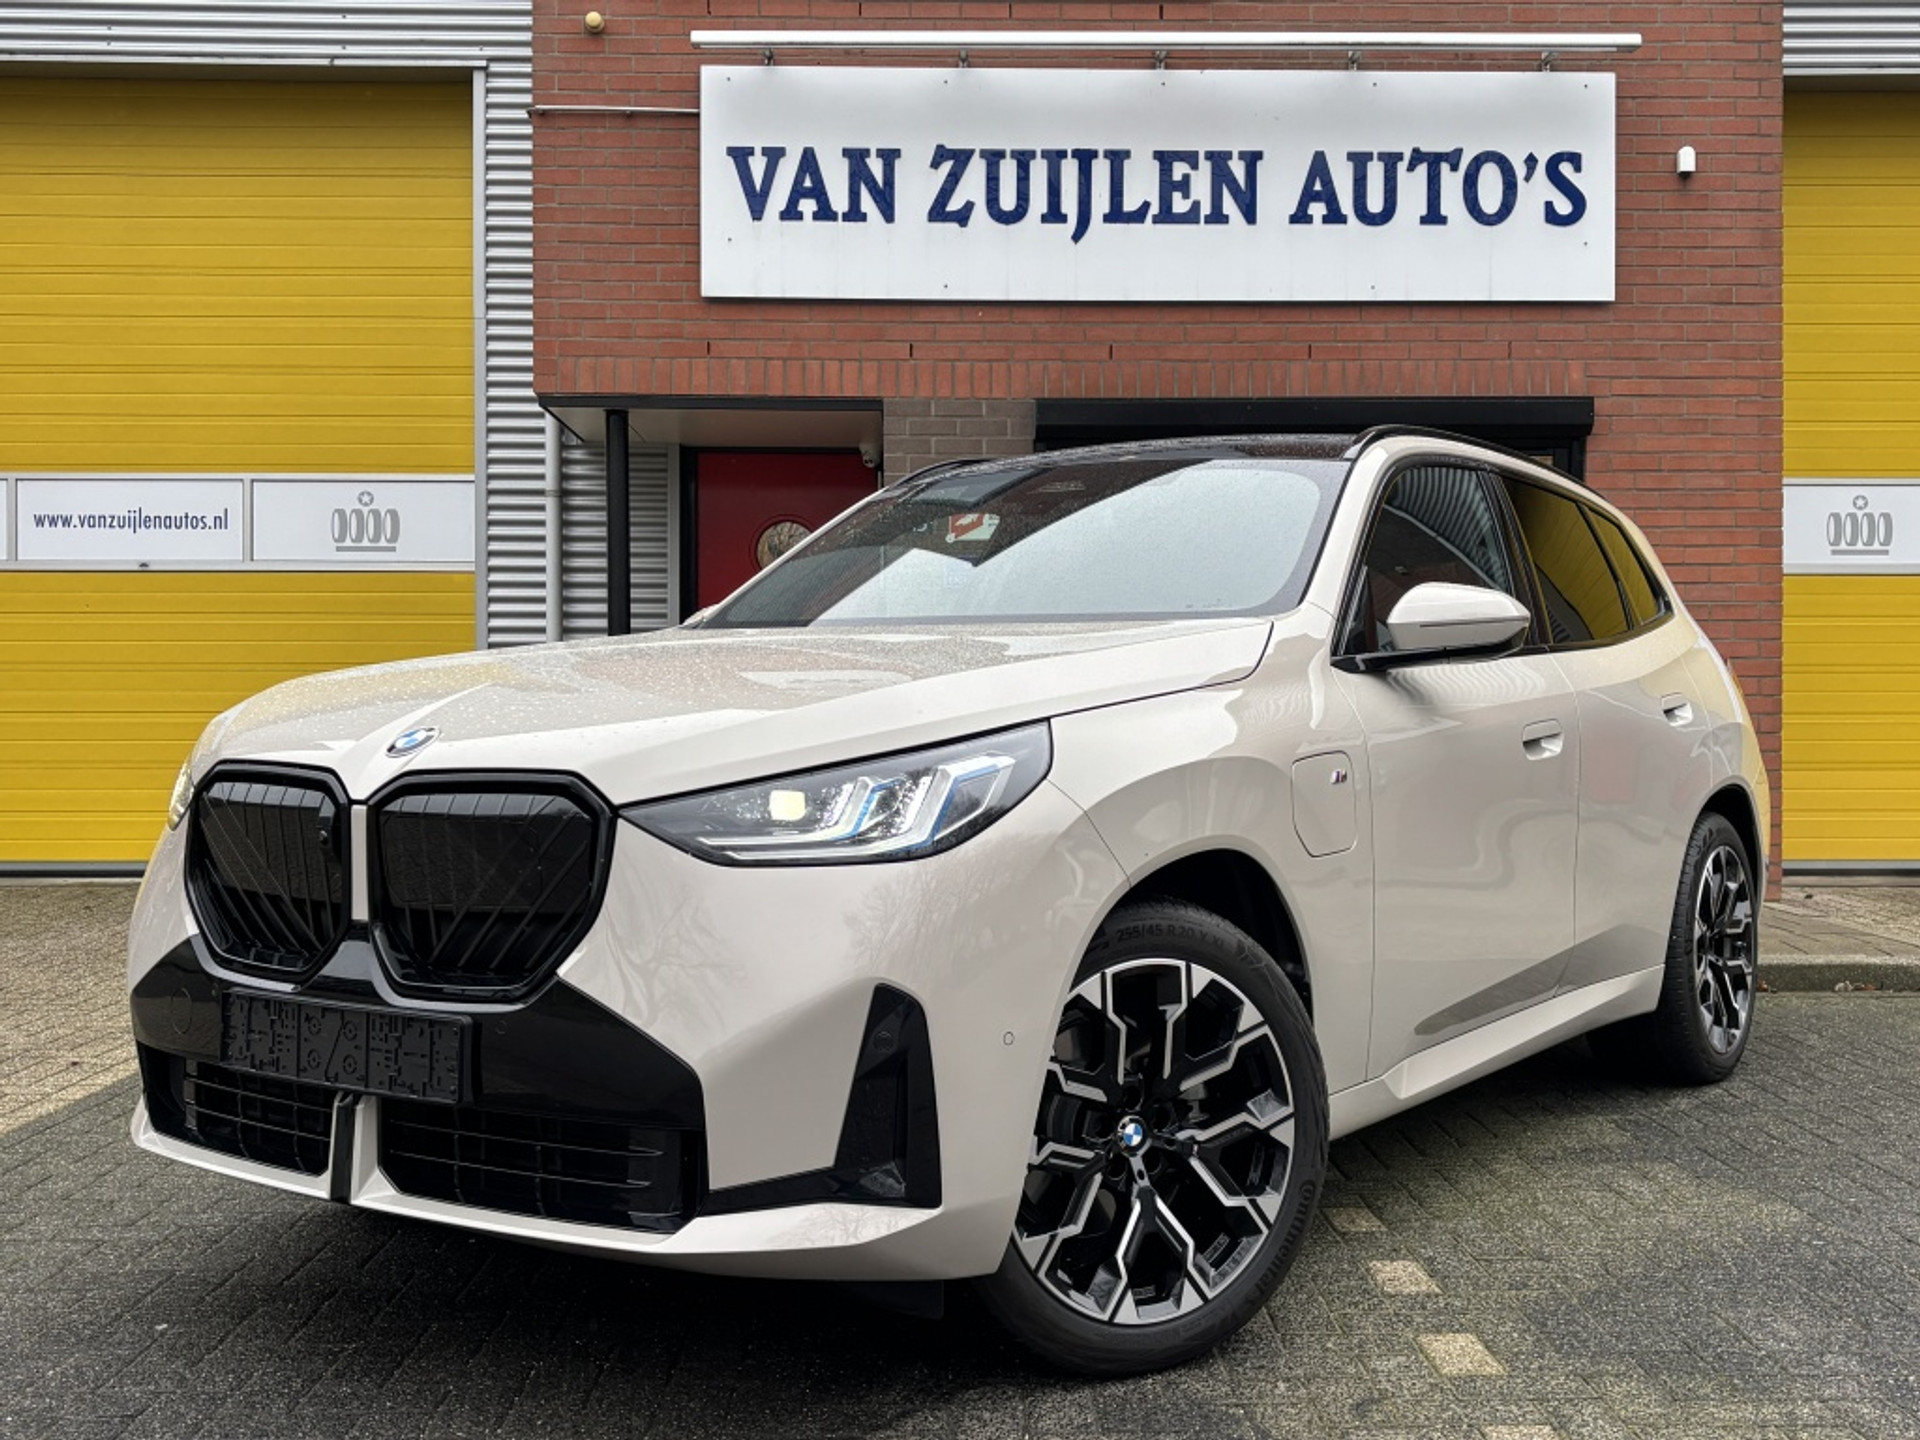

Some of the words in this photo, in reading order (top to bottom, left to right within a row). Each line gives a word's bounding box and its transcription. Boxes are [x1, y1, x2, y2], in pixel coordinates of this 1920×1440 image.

[727, 146, 902, 224] VAN
[928, 143, 1264, 245] ZUIJLEN
[1289, 146, 1587, 228] AUTO'S
[33, 507, 229, 534] www.vanzuijlenautos.nl
